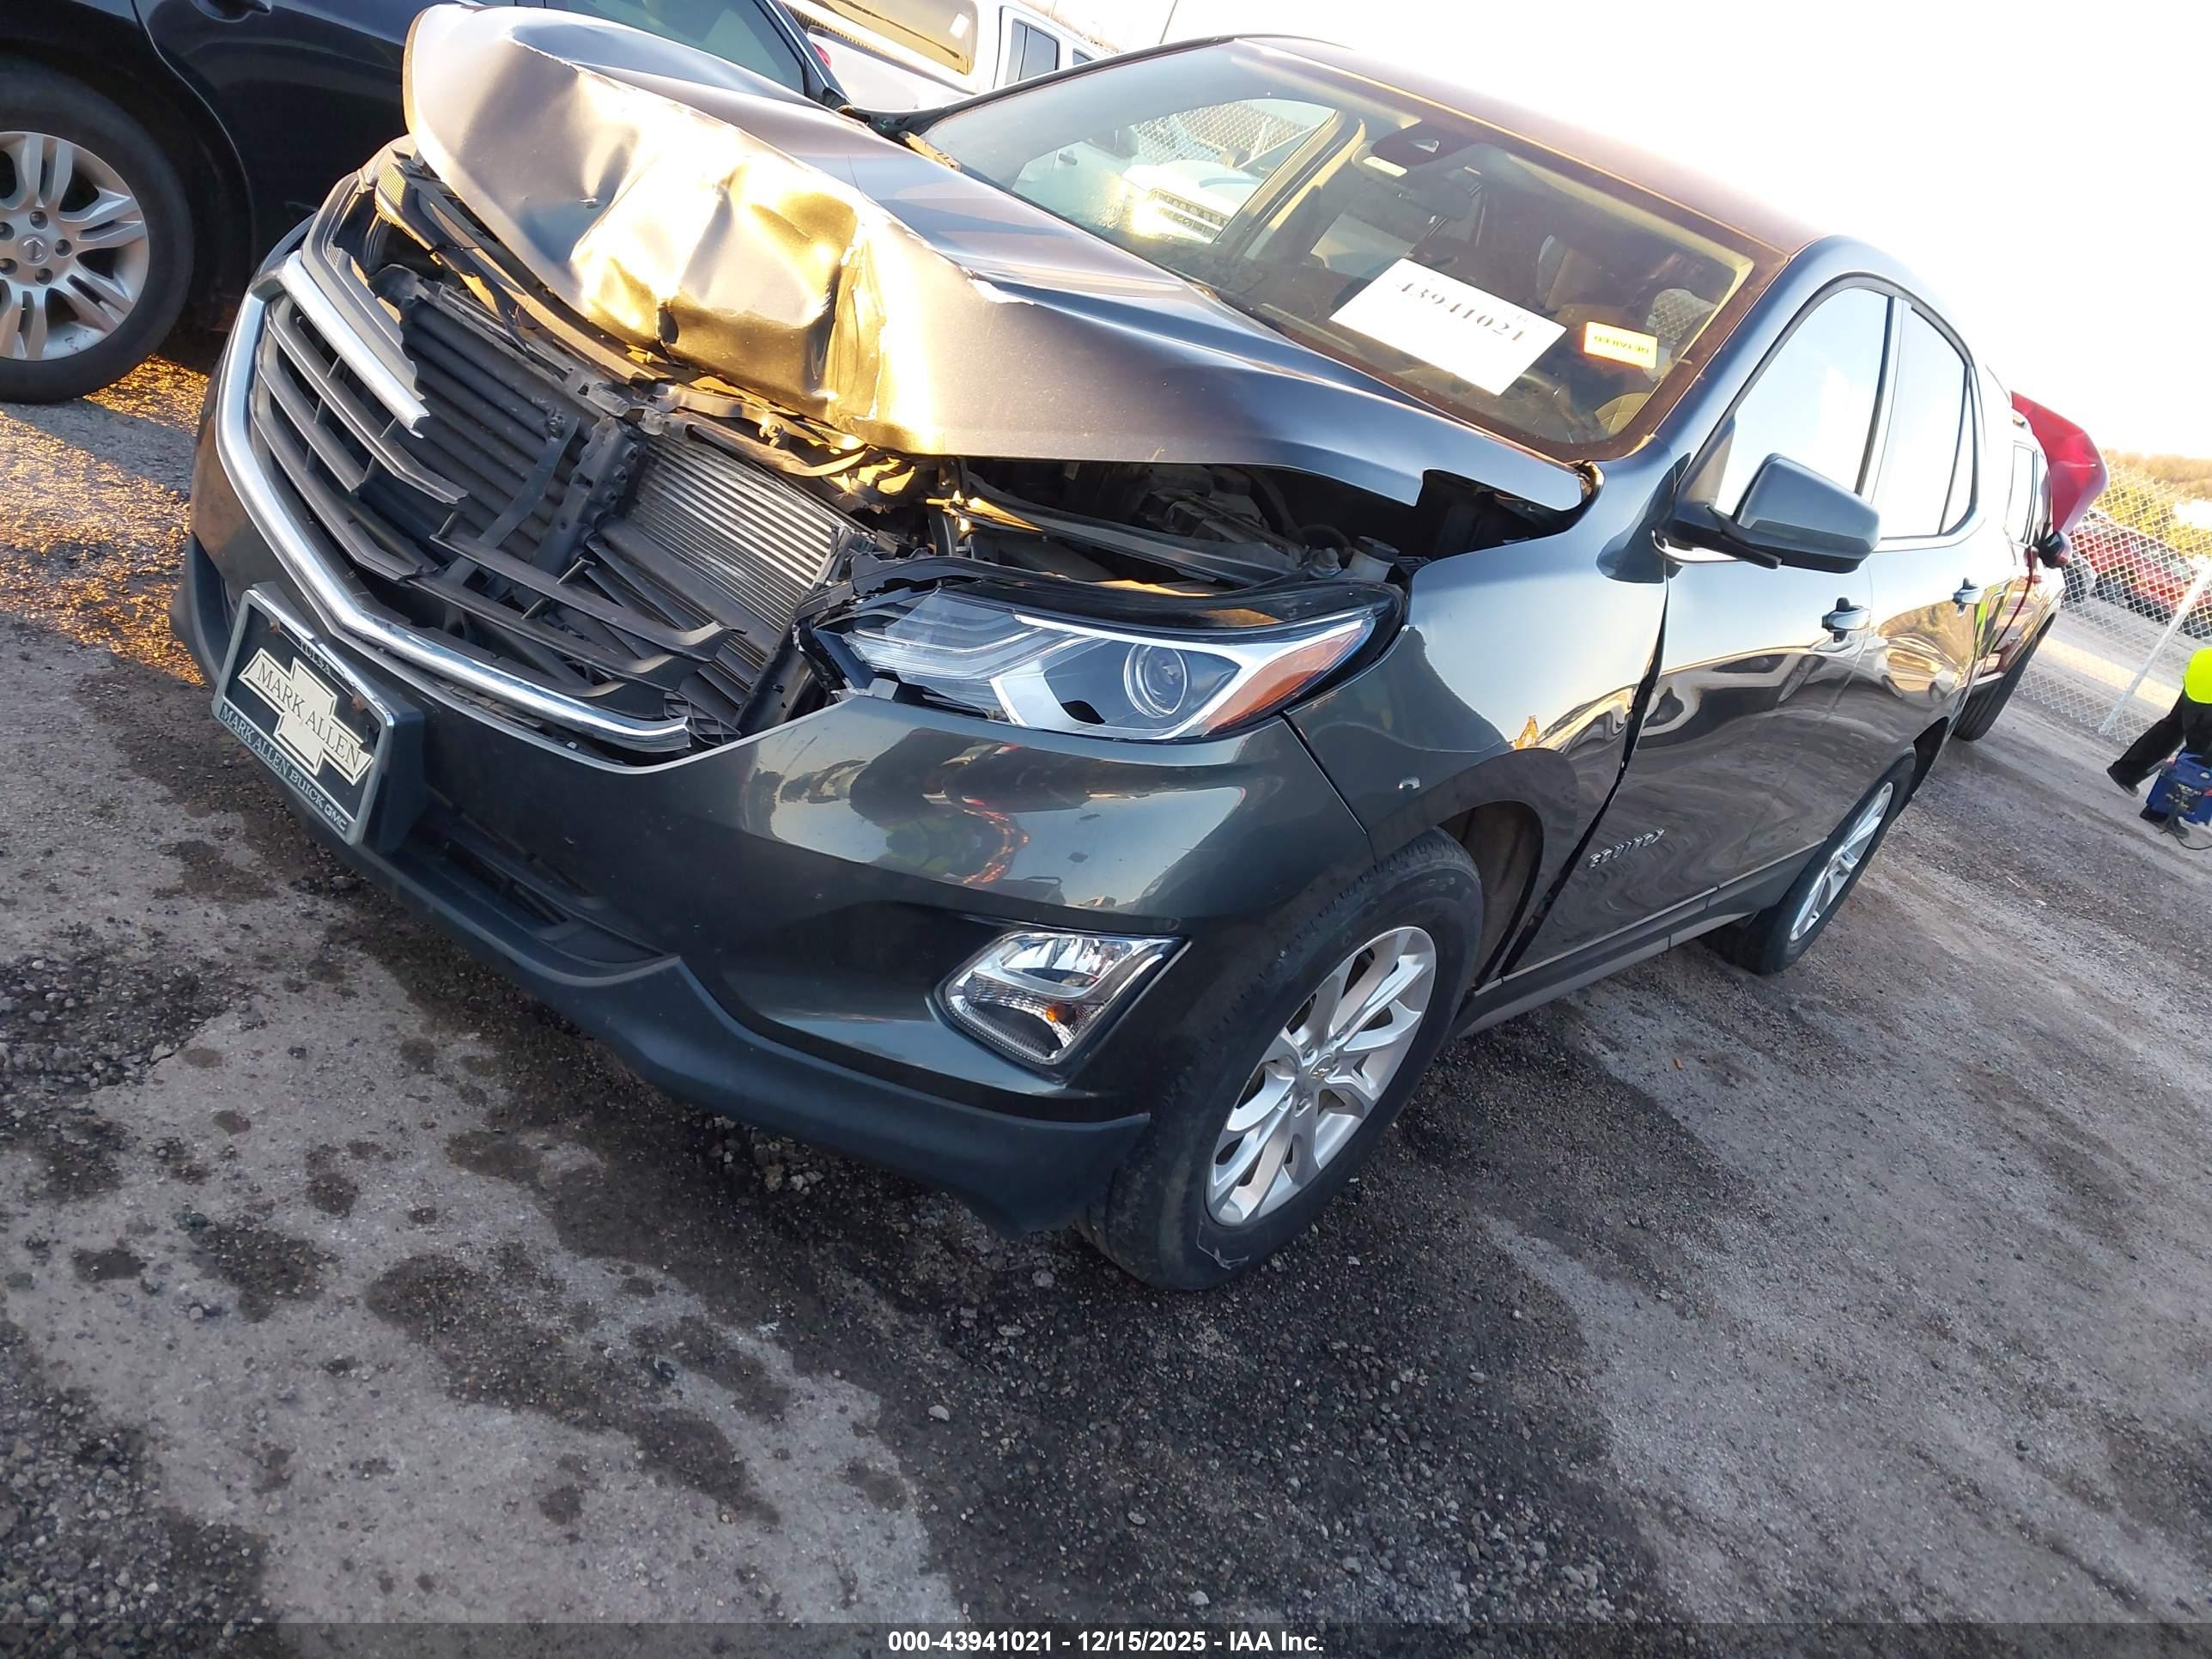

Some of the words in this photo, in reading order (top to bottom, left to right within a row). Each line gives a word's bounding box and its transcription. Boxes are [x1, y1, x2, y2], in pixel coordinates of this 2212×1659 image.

[1397, 281, 1525, 343] 43941021
[257, 661, 304, 718] MARK
[305, 710, 362, 770] ALLEN
[221, 705, 255, 744] MARK
[252, 737, 290, 781] ALLEN
[289, 769, 325, 810] BUICK
[324, 803, 349, 831] GMC
[1589, 827, 1666, 869] EQUINOX
